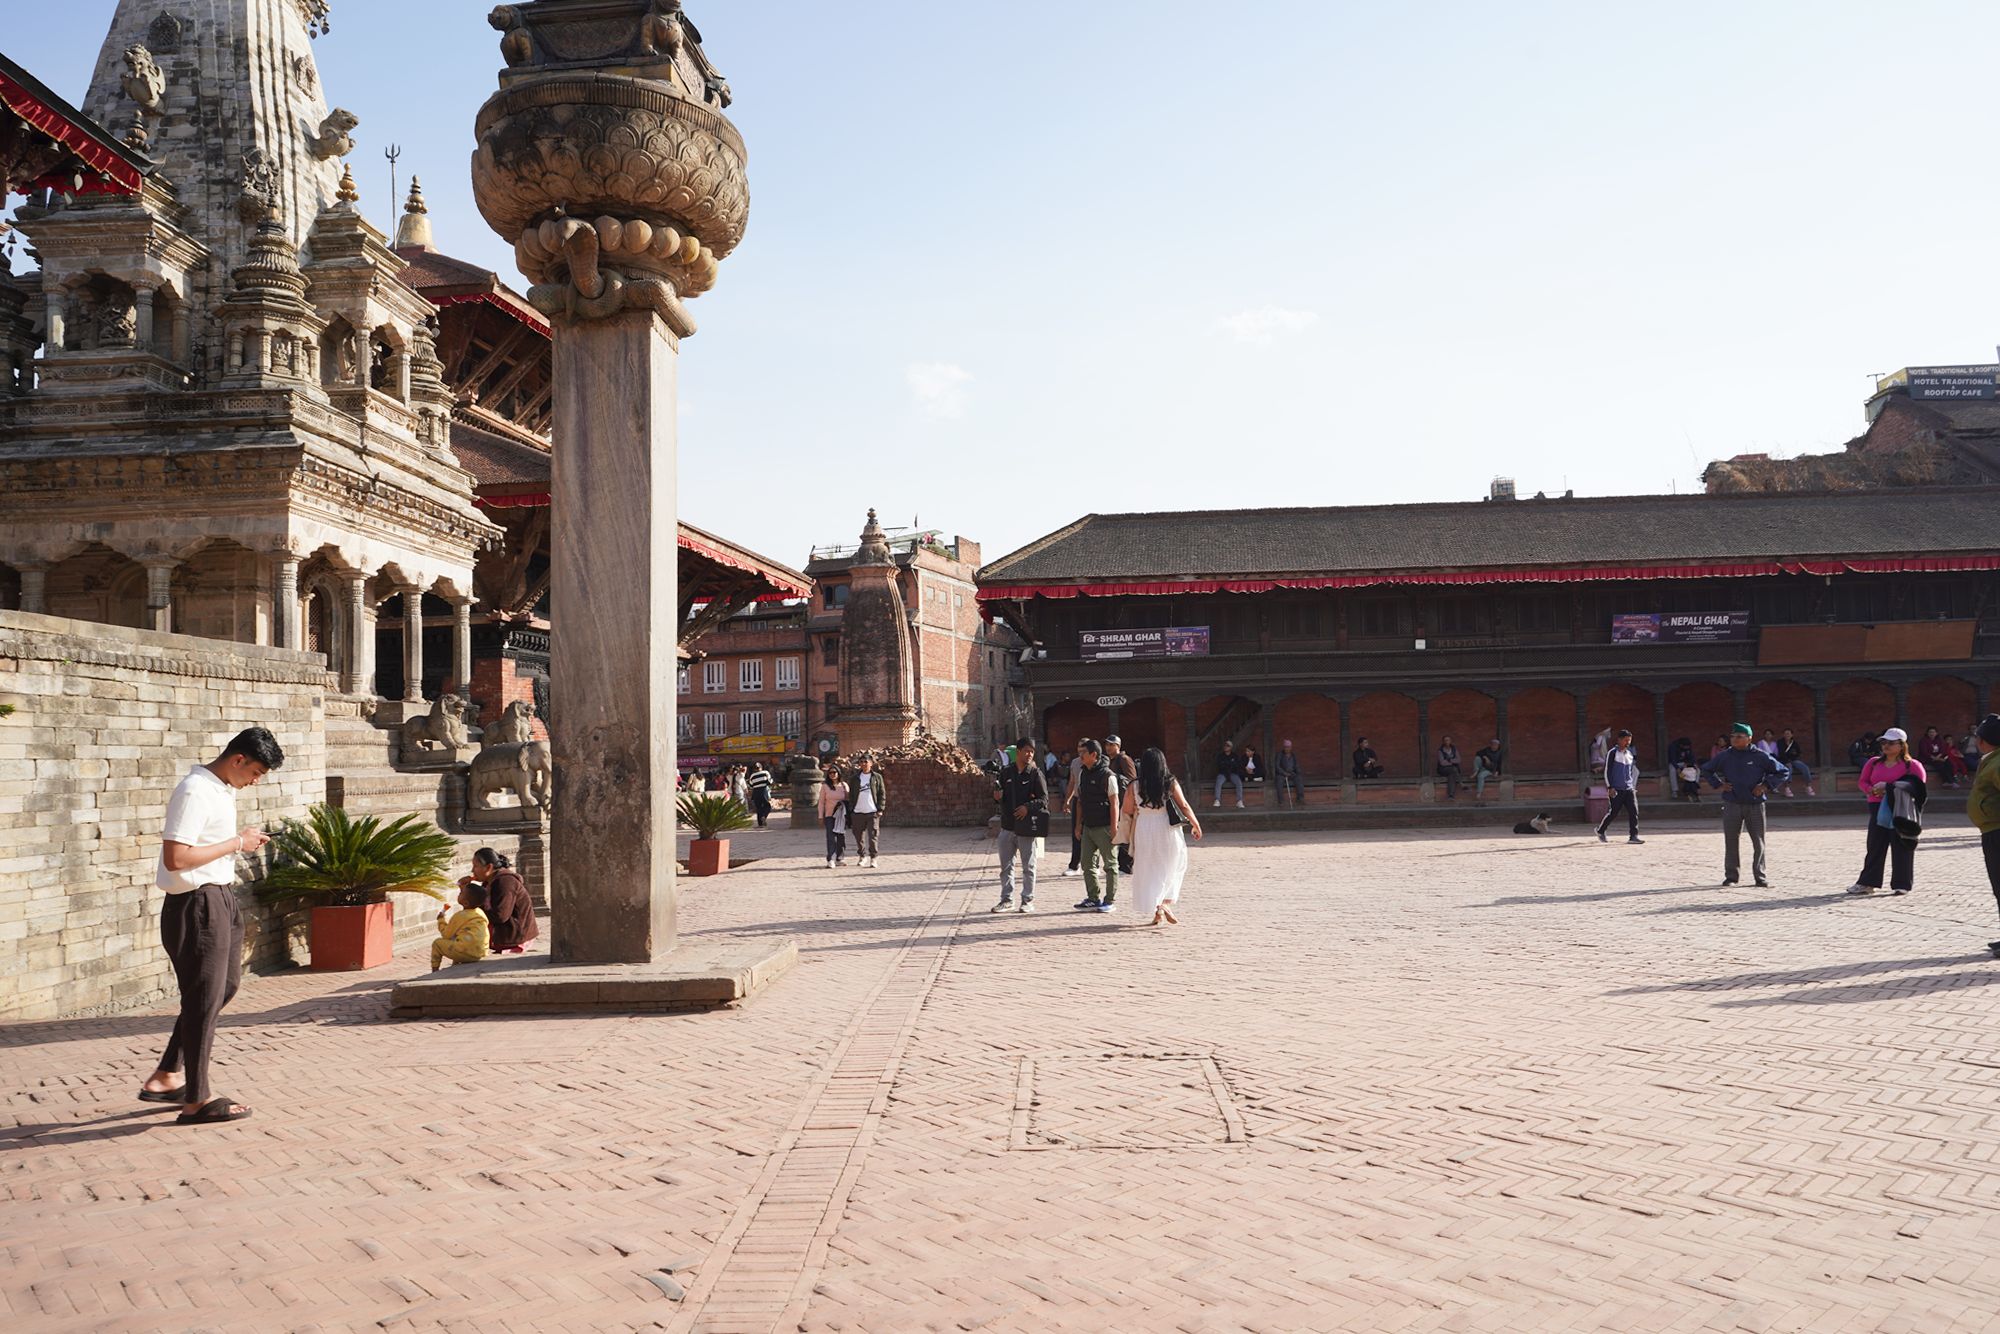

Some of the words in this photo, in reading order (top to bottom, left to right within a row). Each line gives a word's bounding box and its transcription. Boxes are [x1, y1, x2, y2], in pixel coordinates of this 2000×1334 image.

[1671, 616, 1702, 627] NEPALI
[1704, 615, 1729, 626] GHAR
[1135, 633, 1161, 642] GHAR
[1438, 638, 1519, 647] RESTAURANT
[1100, 697, 1125, 705] OPEN
